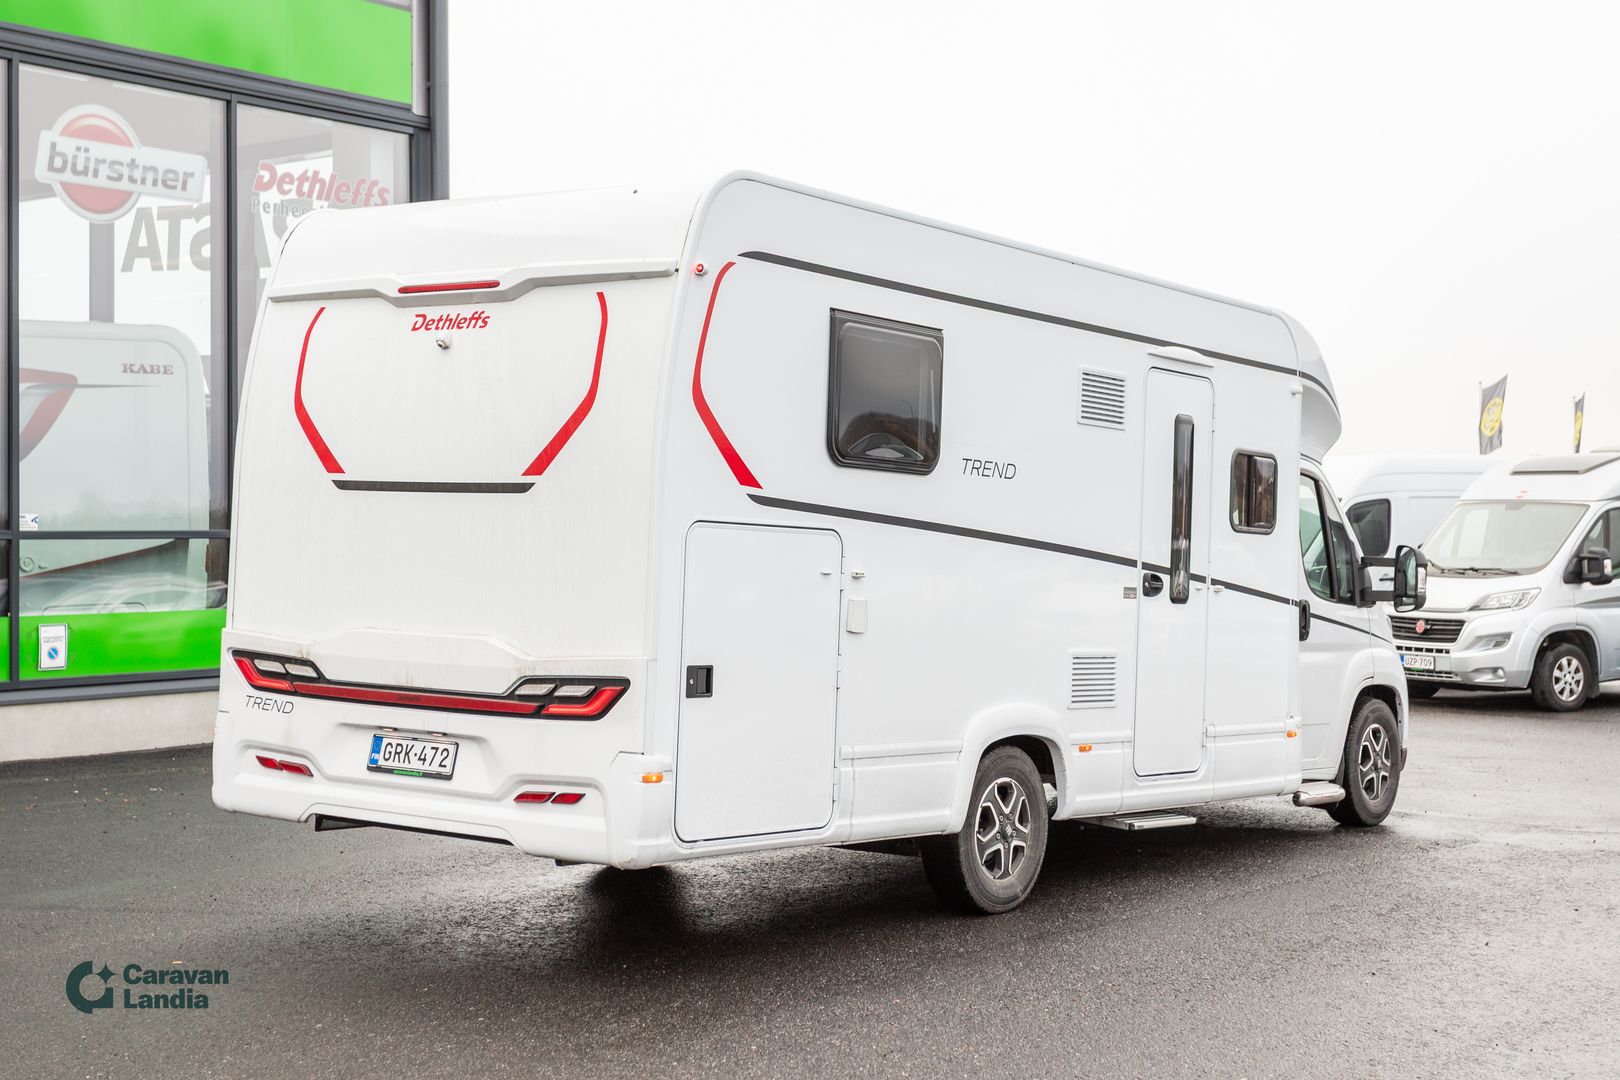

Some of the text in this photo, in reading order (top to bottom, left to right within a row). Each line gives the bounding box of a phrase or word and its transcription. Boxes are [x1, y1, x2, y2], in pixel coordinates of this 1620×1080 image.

[47, 141, 195, 192] bürstner
[253, 162, 390, 207] Dethleffs
[410, 310, 490, 332] Dethleffs
[121, 363, 174, 375] KABE
[962, 457, 1017, 480] TREND
[245, 694, 295, 714] TREND
[383, 741, 450, 768] GRK-472
